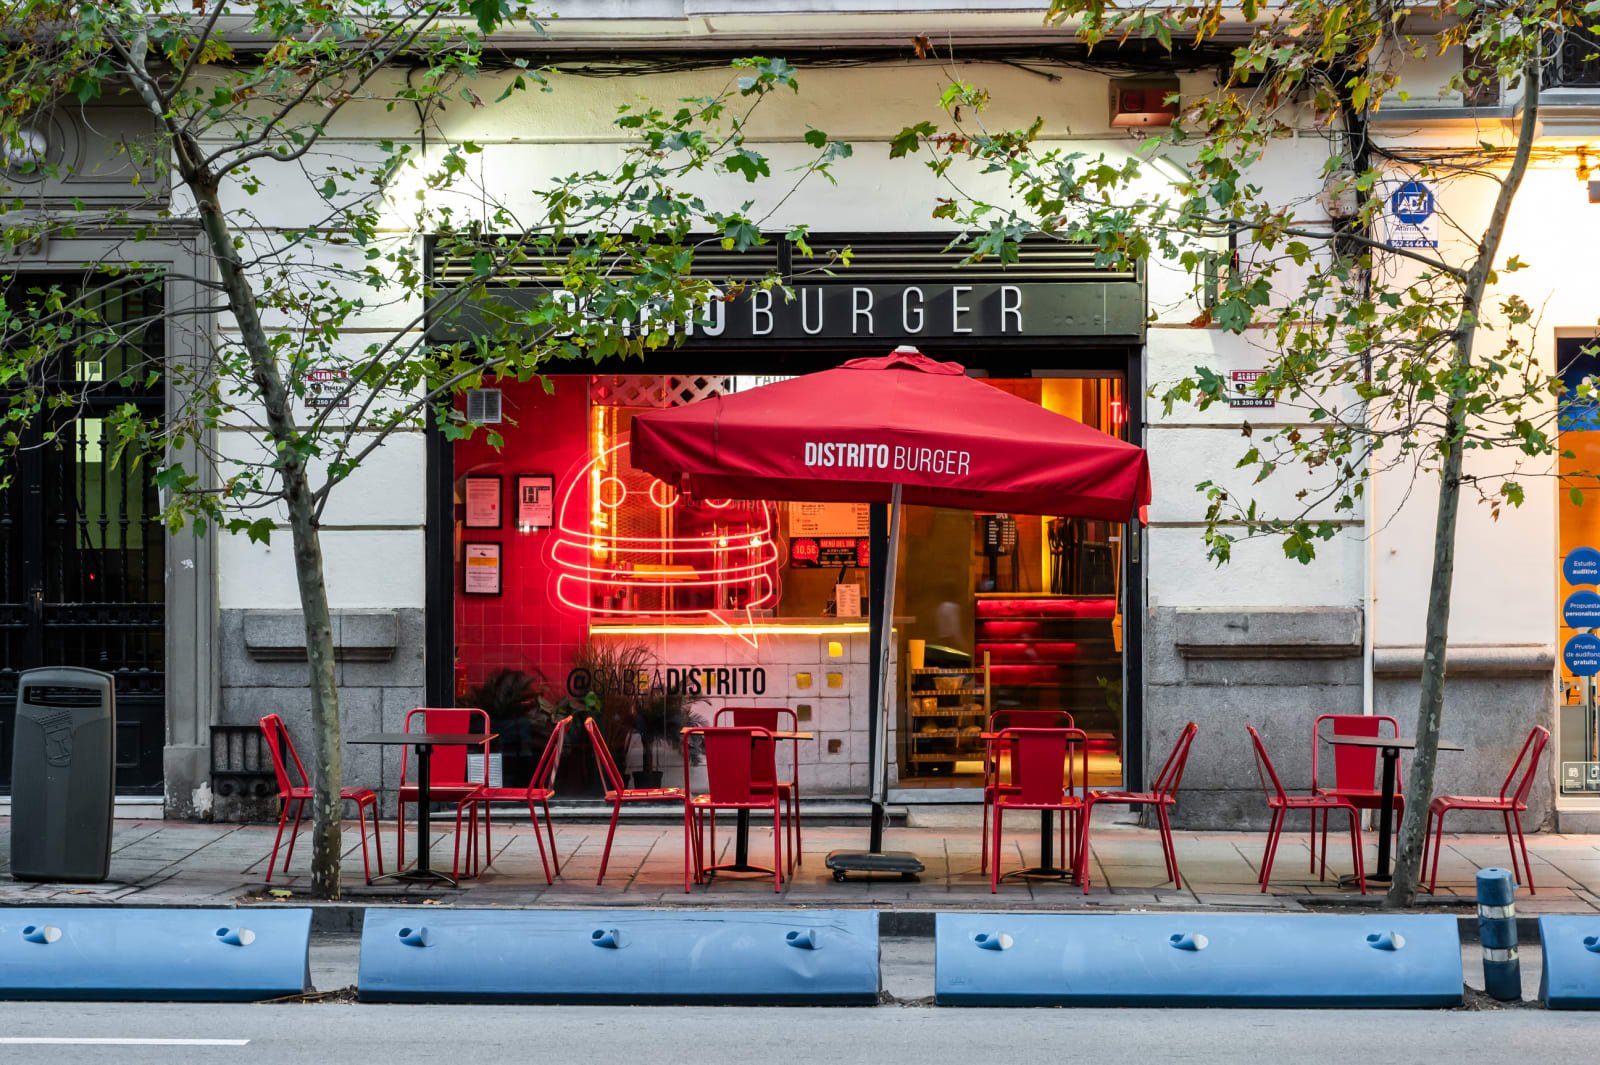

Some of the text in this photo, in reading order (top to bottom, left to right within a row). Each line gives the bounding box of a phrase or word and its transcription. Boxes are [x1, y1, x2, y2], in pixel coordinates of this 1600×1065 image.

[752, 285, 1023, 335] BURGER
[804, 441, 970, 475] DISTRITO BURGER
